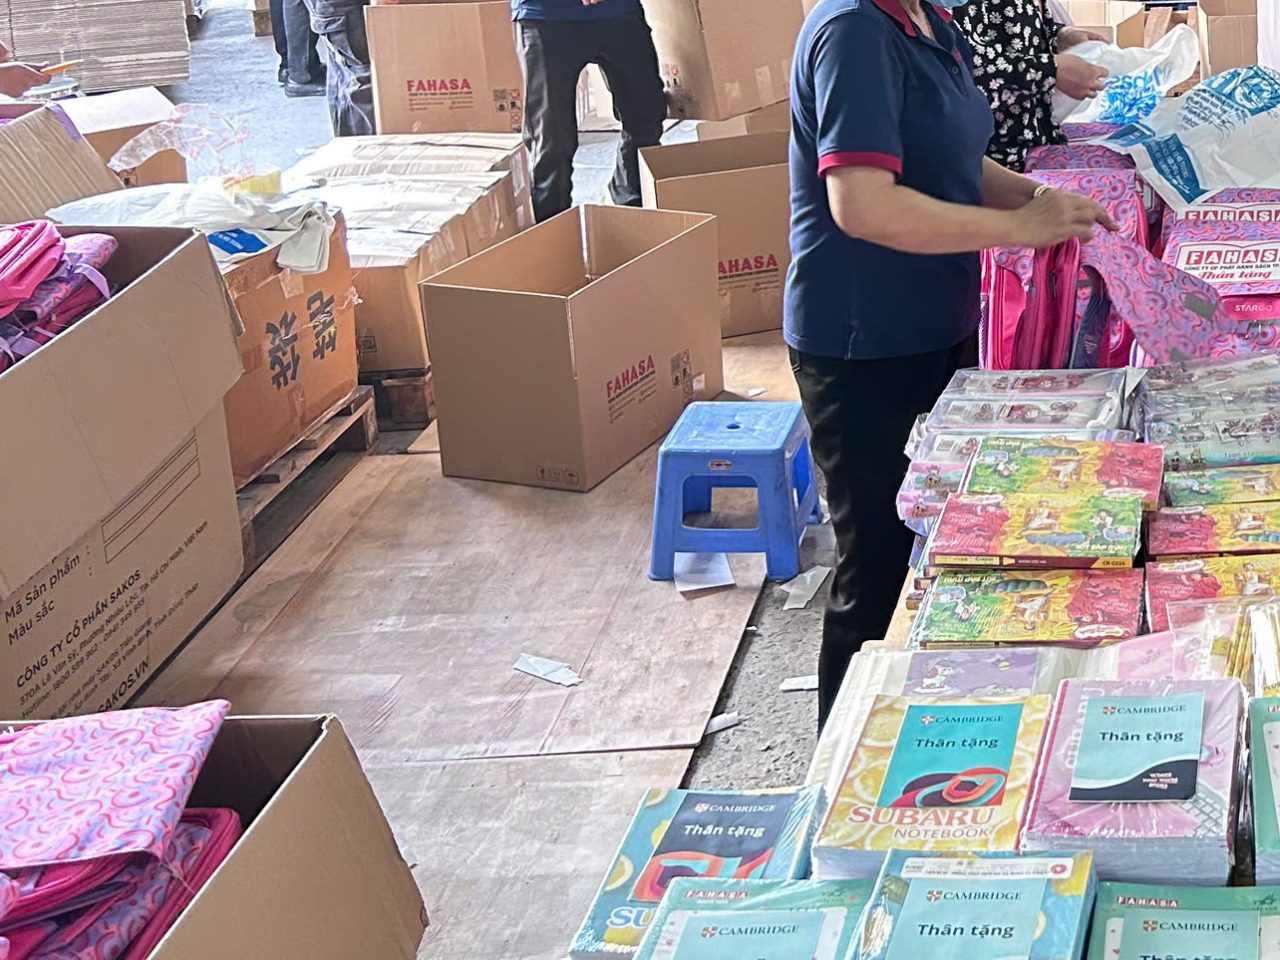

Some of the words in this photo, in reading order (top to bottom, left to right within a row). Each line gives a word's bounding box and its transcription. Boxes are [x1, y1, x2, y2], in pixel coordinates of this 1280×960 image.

[406, 78, 472, 92] FAHASA
[718, 253, 778, 275] AHASA
[606, 354, 655, 399] FAHASA
[5, 600, 23, 624] Mã
[25, 584, 47, 606] Sản
[49, 554, 80, 589] phẩm
[8, 618, 33, 646] Màu
[35, 600, 55, 622] sắc
[16, 654, 48, 688] CÔNG
[49, 639, 63, 658] TY
[65, 619, 81, 644] CỔ
[109, 568, 141, 604] SAKOS
[1117, 704, 1187, 715] CAMBRIDGE
[934, 715, 1004, 724] CAMBRIDGE
[915, 738, 956, 749] Thân
[961, 738, 999, 749] tặng
[1099, 731, 1141, 742] Thân
[1145, 731, 1184, 743] tặng
[709, 803, 776, 813] CAMBRIDGE
[848, 805, 997, 827] SUBARU
[684, 824, 723, 836] Thân
[727, 824, 766, 838] tặng
[893, 827, 991, 840] NOTEBOOK
[943, 890, 1023, 902] CAMBRIDGE
[1116, 896, 1179, 908] FAHASA
[718, 924, 799, 937] CAMBRIDGE
[917, 923, 959, 937] Thân
[970, 923, 1015, 939] tặng
[1159, 921, 1239, 932] CAMBRIDGE
